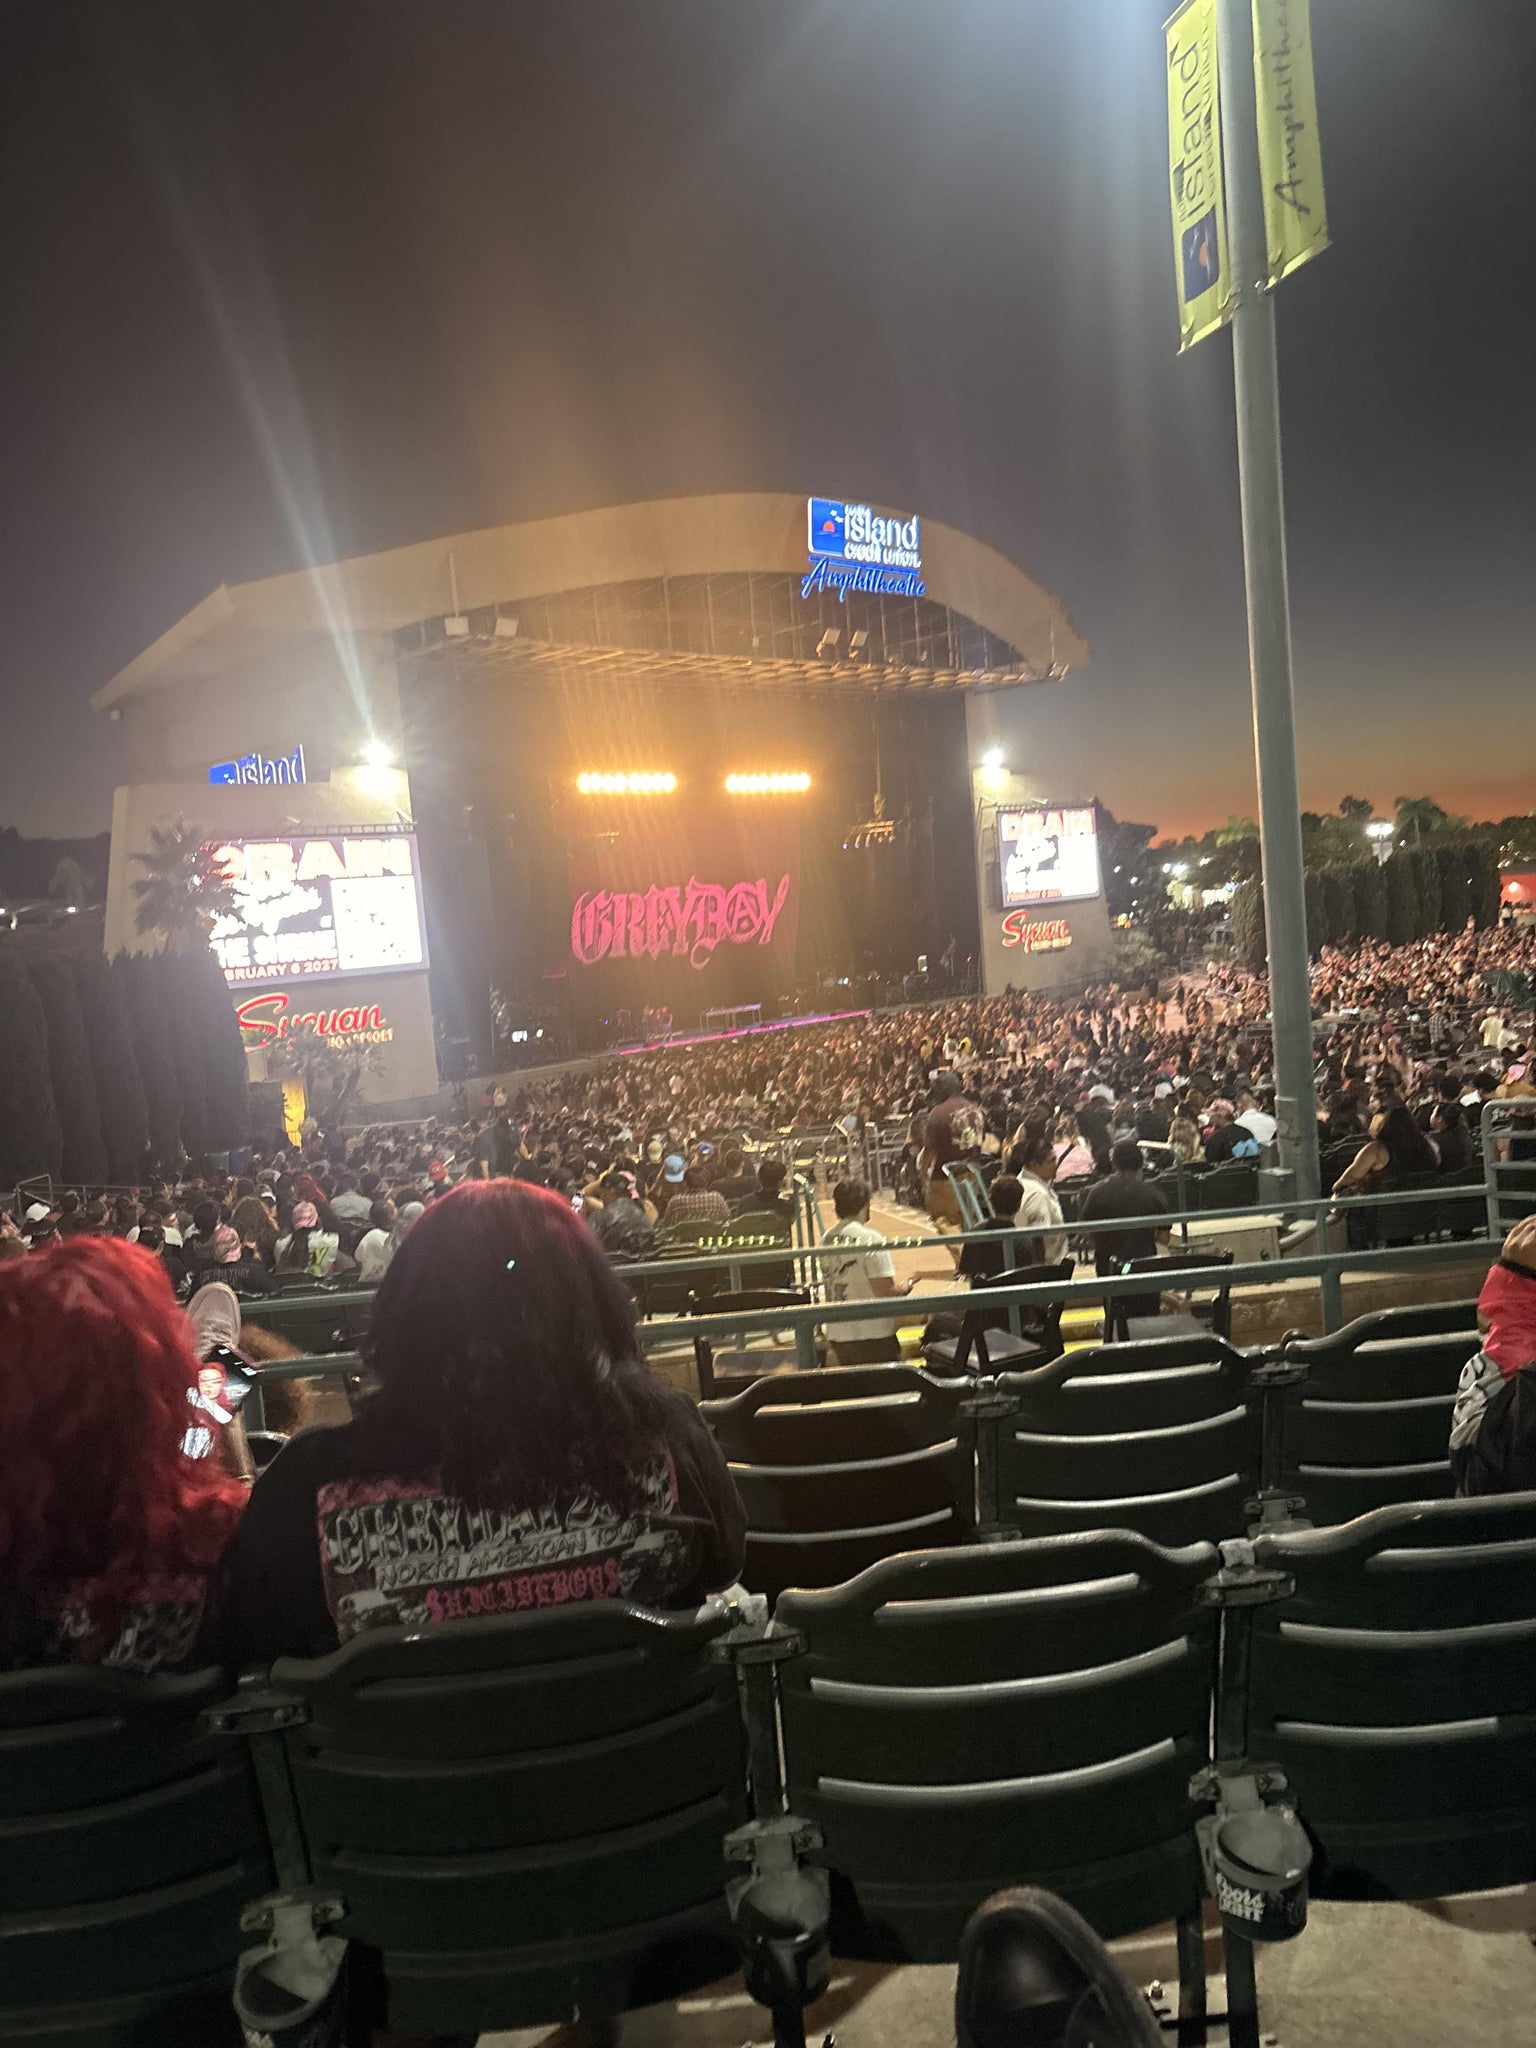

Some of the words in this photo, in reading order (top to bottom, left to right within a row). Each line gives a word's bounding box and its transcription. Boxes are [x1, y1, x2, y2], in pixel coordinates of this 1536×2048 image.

[1171, 41, 1205, 218] island
[1272, 0, 1311, 216] Amphithea
[223, 963, 288, 982] BRUARY
[303, 959, 339, 974] 2027
[376, 1553, 460, 1592] NORTH
[466, 1531, 587, 1577] AMERICAN
